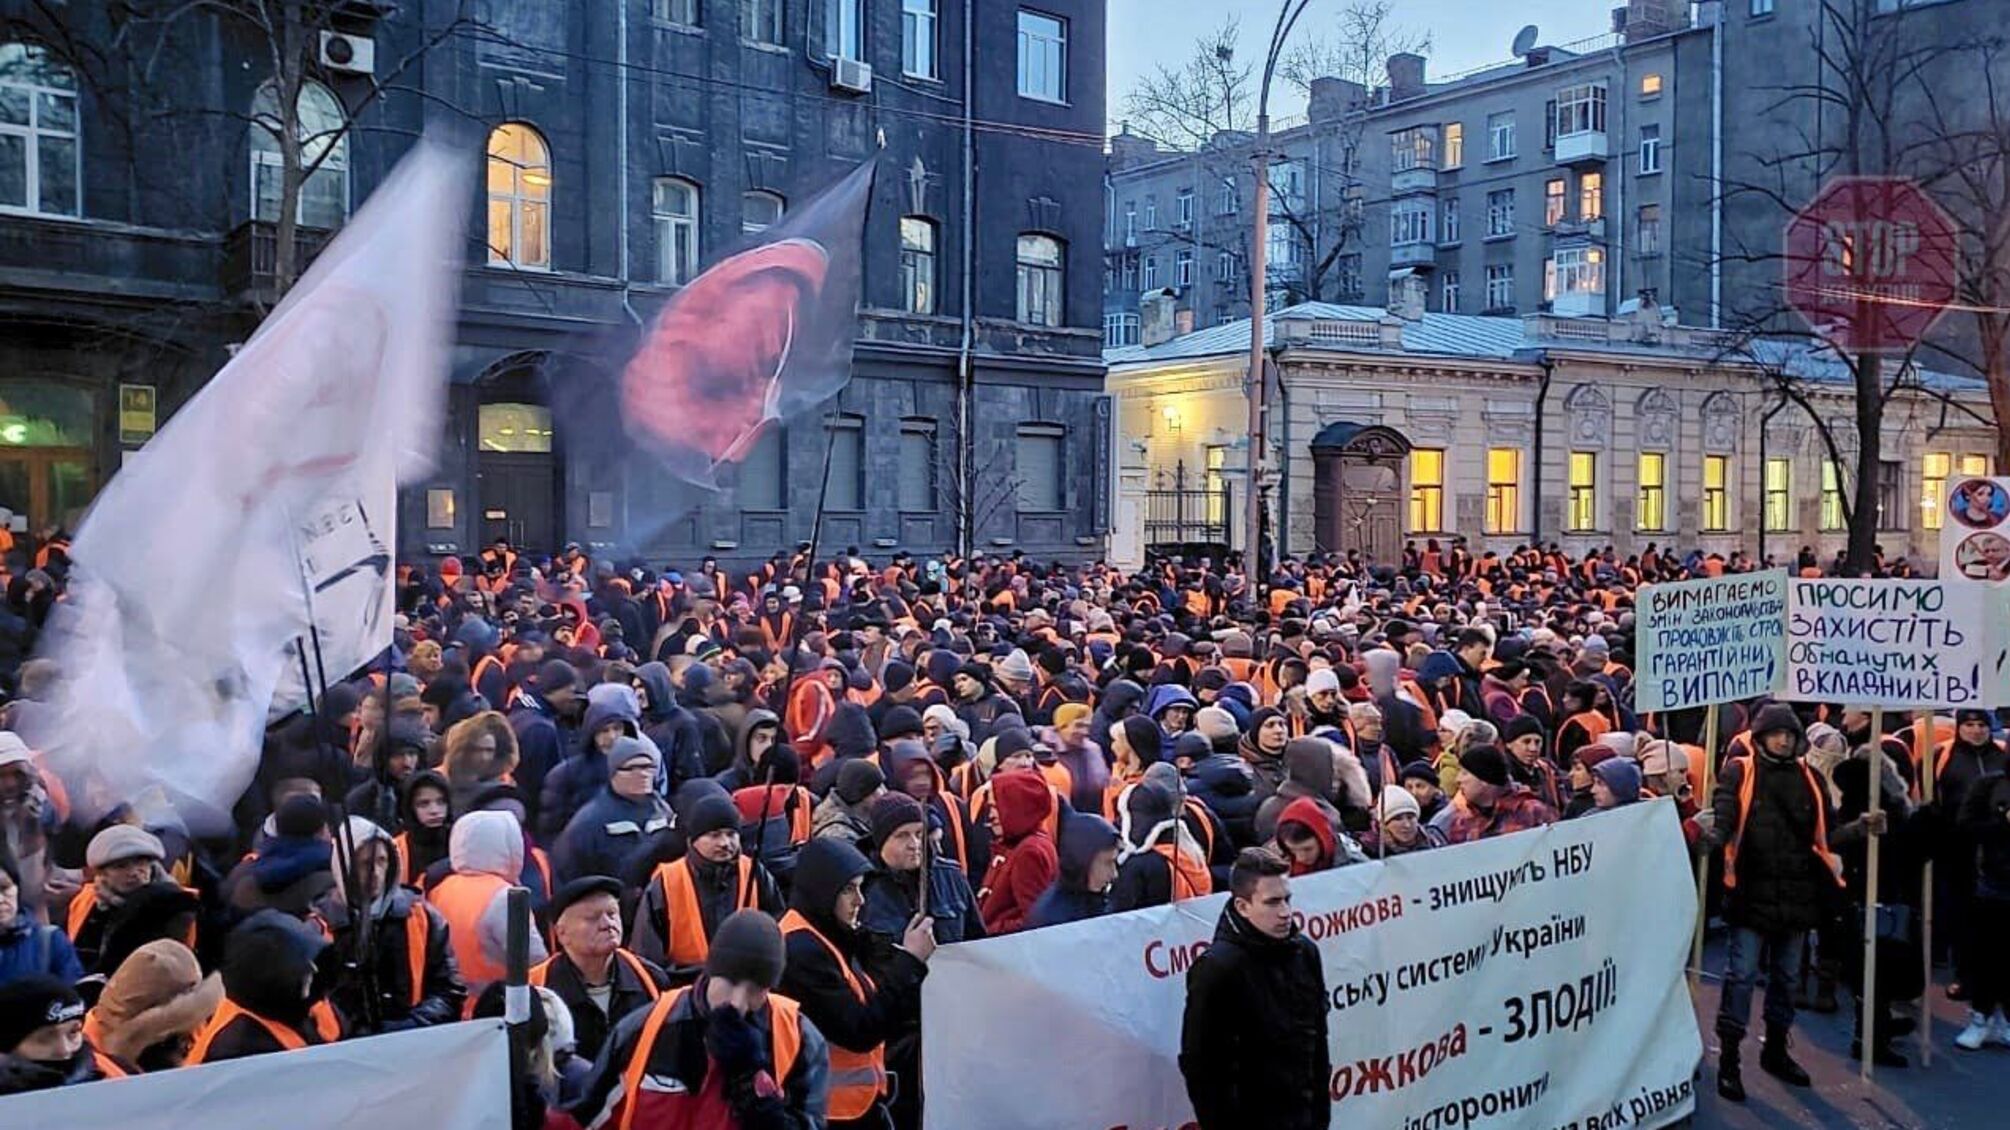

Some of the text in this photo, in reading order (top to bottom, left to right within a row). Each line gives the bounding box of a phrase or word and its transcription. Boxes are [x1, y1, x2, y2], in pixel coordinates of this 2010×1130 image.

[1652, 580, 1777, 613] ВИМАГАЄМО
[1797, 582, 1944, 612] ПРОСИМО
[1662, 659, 1775, 708] ВИПЛАТ!
[1144, 939, 1213, 979] Смо
[1553, 841, 1594, 879] НБУ
[1325, 971, 1390, 1011] ську
[1490, 913, 1586, 960] України
[1330, 1022, 1467, 1102] ожкова
[1503, 957, 1617, 1044] ЗЛОДІЇ!
[1629, 1079, 1693, 1127] рівня
